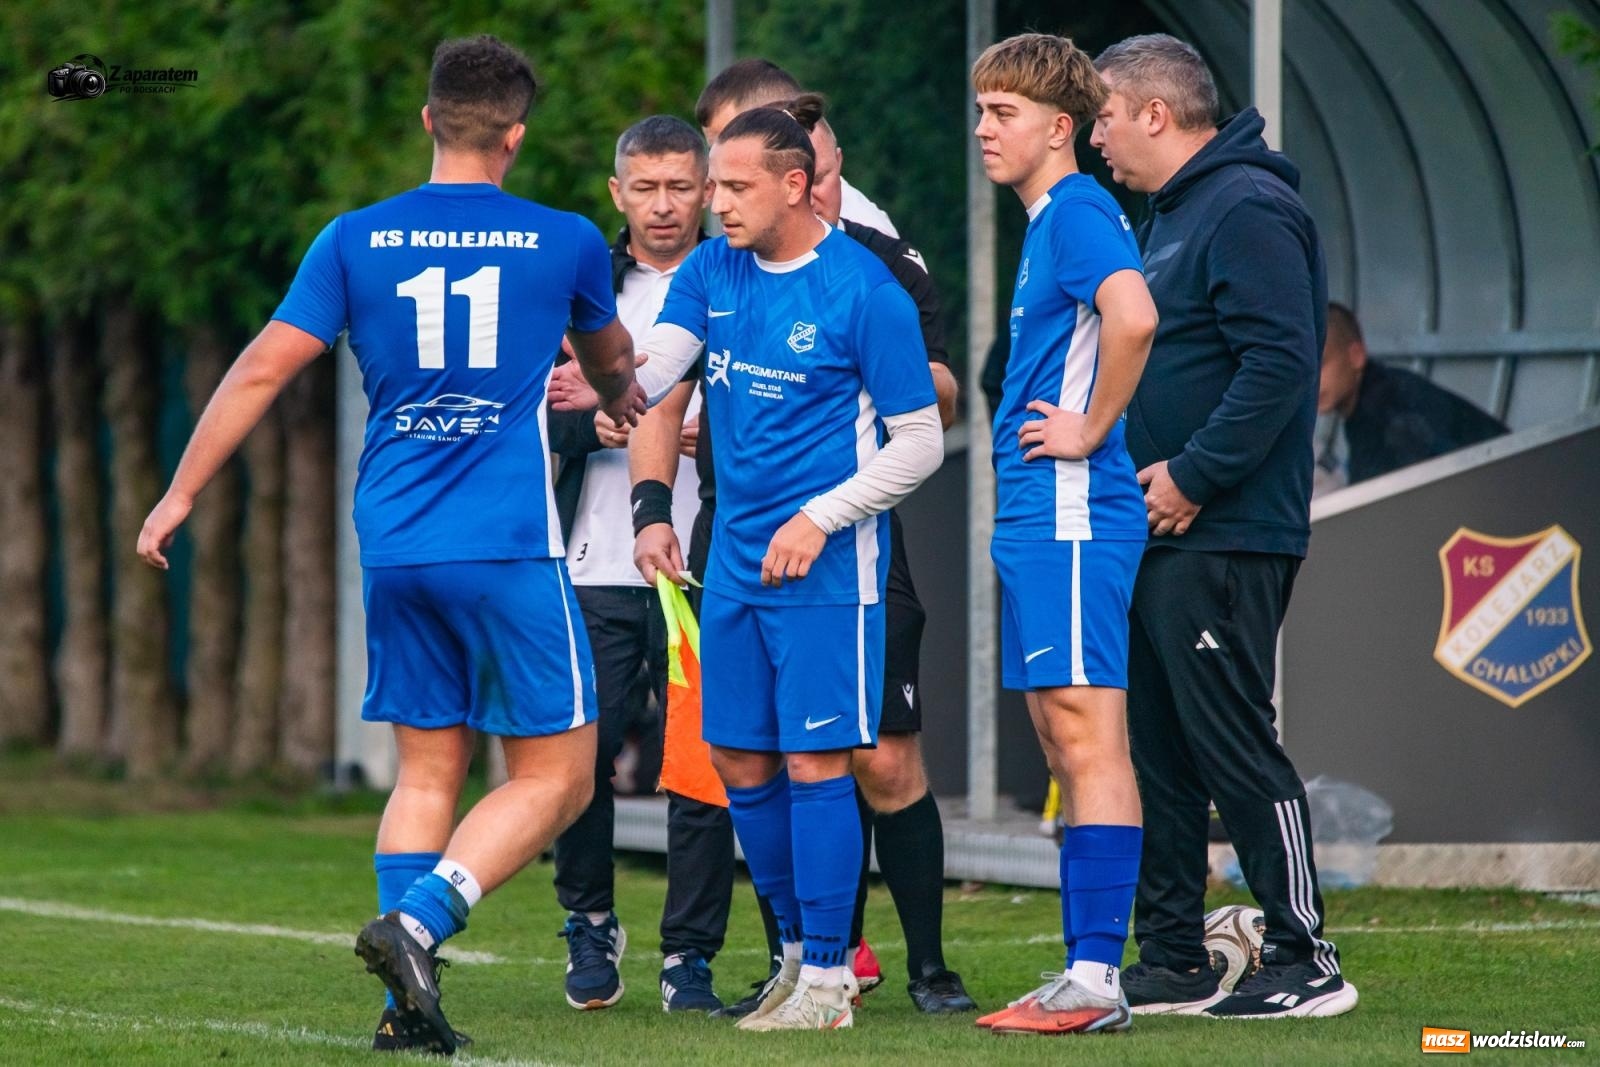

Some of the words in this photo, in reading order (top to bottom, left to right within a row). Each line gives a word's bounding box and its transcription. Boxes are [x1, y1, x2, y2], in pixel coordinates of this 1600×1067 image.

[370, 230, 404, 248] KS
[410, 230, 539, 249] KOLEJARZ
[396, 265, 501, 369] 11
[395, 414, 500, 433] DAVE
[1462, 554, 1496, 578] KS
[1450, 541, 1565, 658] KOLEJARZ
[1525, 607, 1570, 627] 1933
